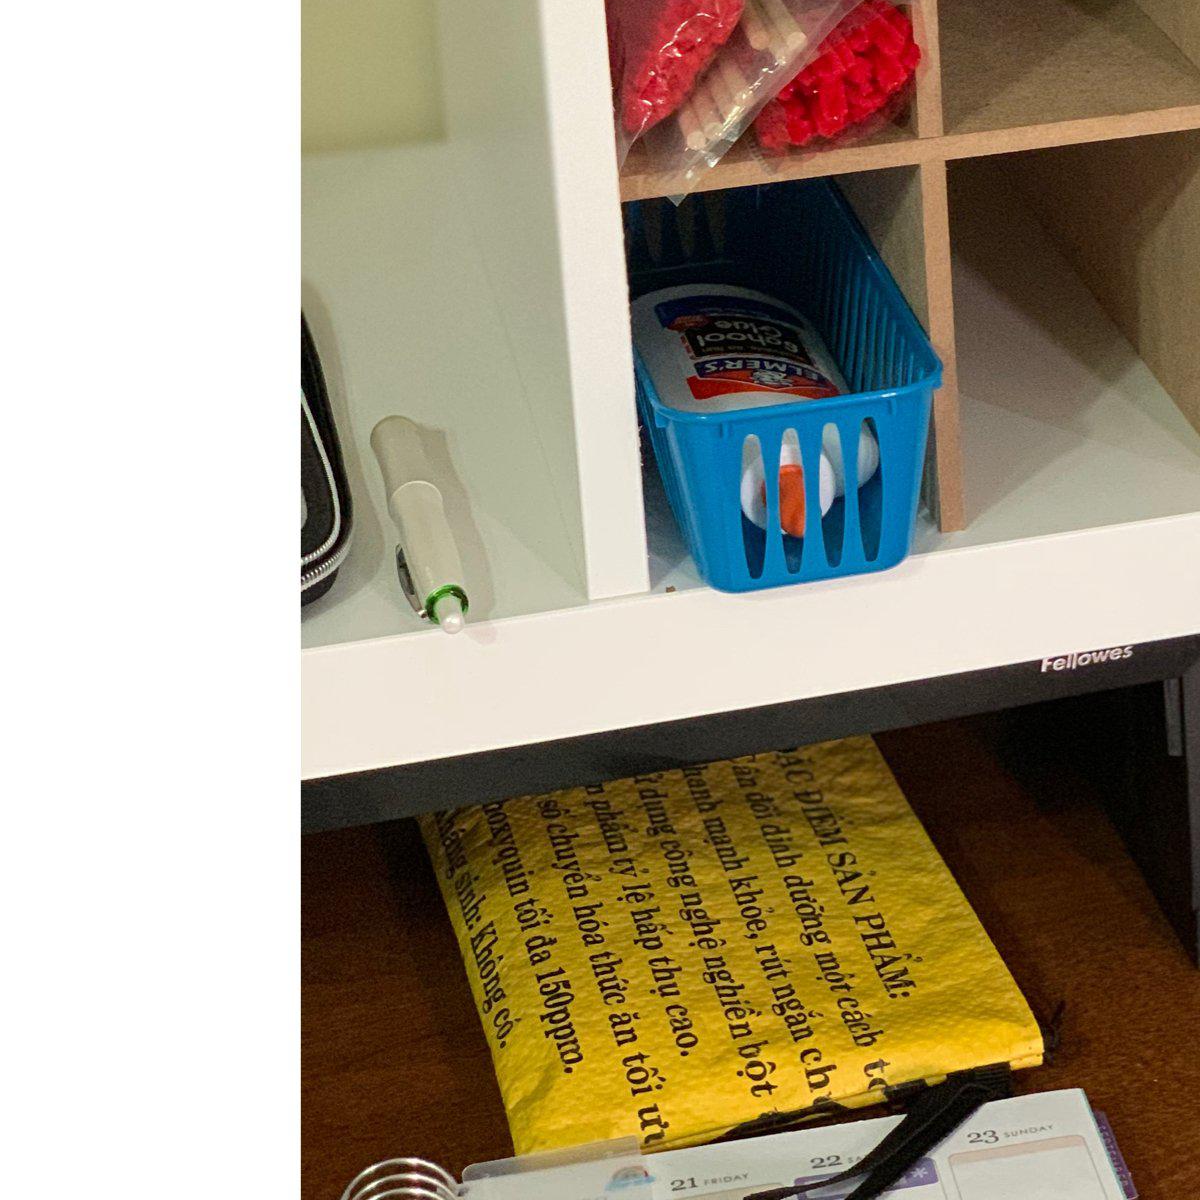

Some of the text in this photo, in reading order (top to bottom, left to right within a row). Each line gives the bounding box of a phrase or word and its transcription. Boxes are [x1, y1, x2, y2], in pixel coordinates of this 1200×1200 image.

[697, 332, 798, 353] School
[715, 319, 783, 339] Glue
[704, 358, 819, 381] ELMER'S
[1040, 645, 1133, 673] Fellowes
[682, 764, 723, 813] hanh
[638, 788, 676, 836] dụng
[547, 824, 602, 899] chuyển
[660, 839, 698, 887] công
[703, 816, 749, 872] mạnh
[608, 857, 649, 878] tỷ
[774, 751, 815, 784] ẶC
[827, 851, 876, 905] SẢN
[853, 911, 923, 998] PHẨM:
[514, 897, 554, 932] tối
[617, 883, 655, 904] lệ
[729, 875, 775, 939] khỏe,
[573, 902, 609, 947] hóa
[630, 906, 674, 950] hấp
[679, 892, 727, 949] nghệ
[760, 824, 803, 868] dinh
[783, 875, 831, 946] dưỡng
[814, 951, 855, 993] một
[837, 997, 884, 1047] cách
[455, 872, 486, 930] sinh:
[471, 920, 506, 1014] Không
[493, 1008, 522, 1049] có.
[525, 934, 557, 966] đa
[755, 943, 792, 980] rút
[589, 951, 629, 1005] thức
[648, 955, 682, 998] thụ
[702, 956, 762, 1040] nghiền
[536, 967, 583, 1073] 150ppm.
[608, 1012, 640, 1047] ăn
[665, 1004, 698, 1057] cao.
[772, 983, 824, 1043] ngắn
[622, 1052, 667, 1097] tối
[737, 1040, 778, 1098] bột
[967, 1124, 1054, 1144] 23 SUNDAY
[670, 1172, 749, 1192] 21 FRIDAY
[810, 1155, 842, 1169] 22
